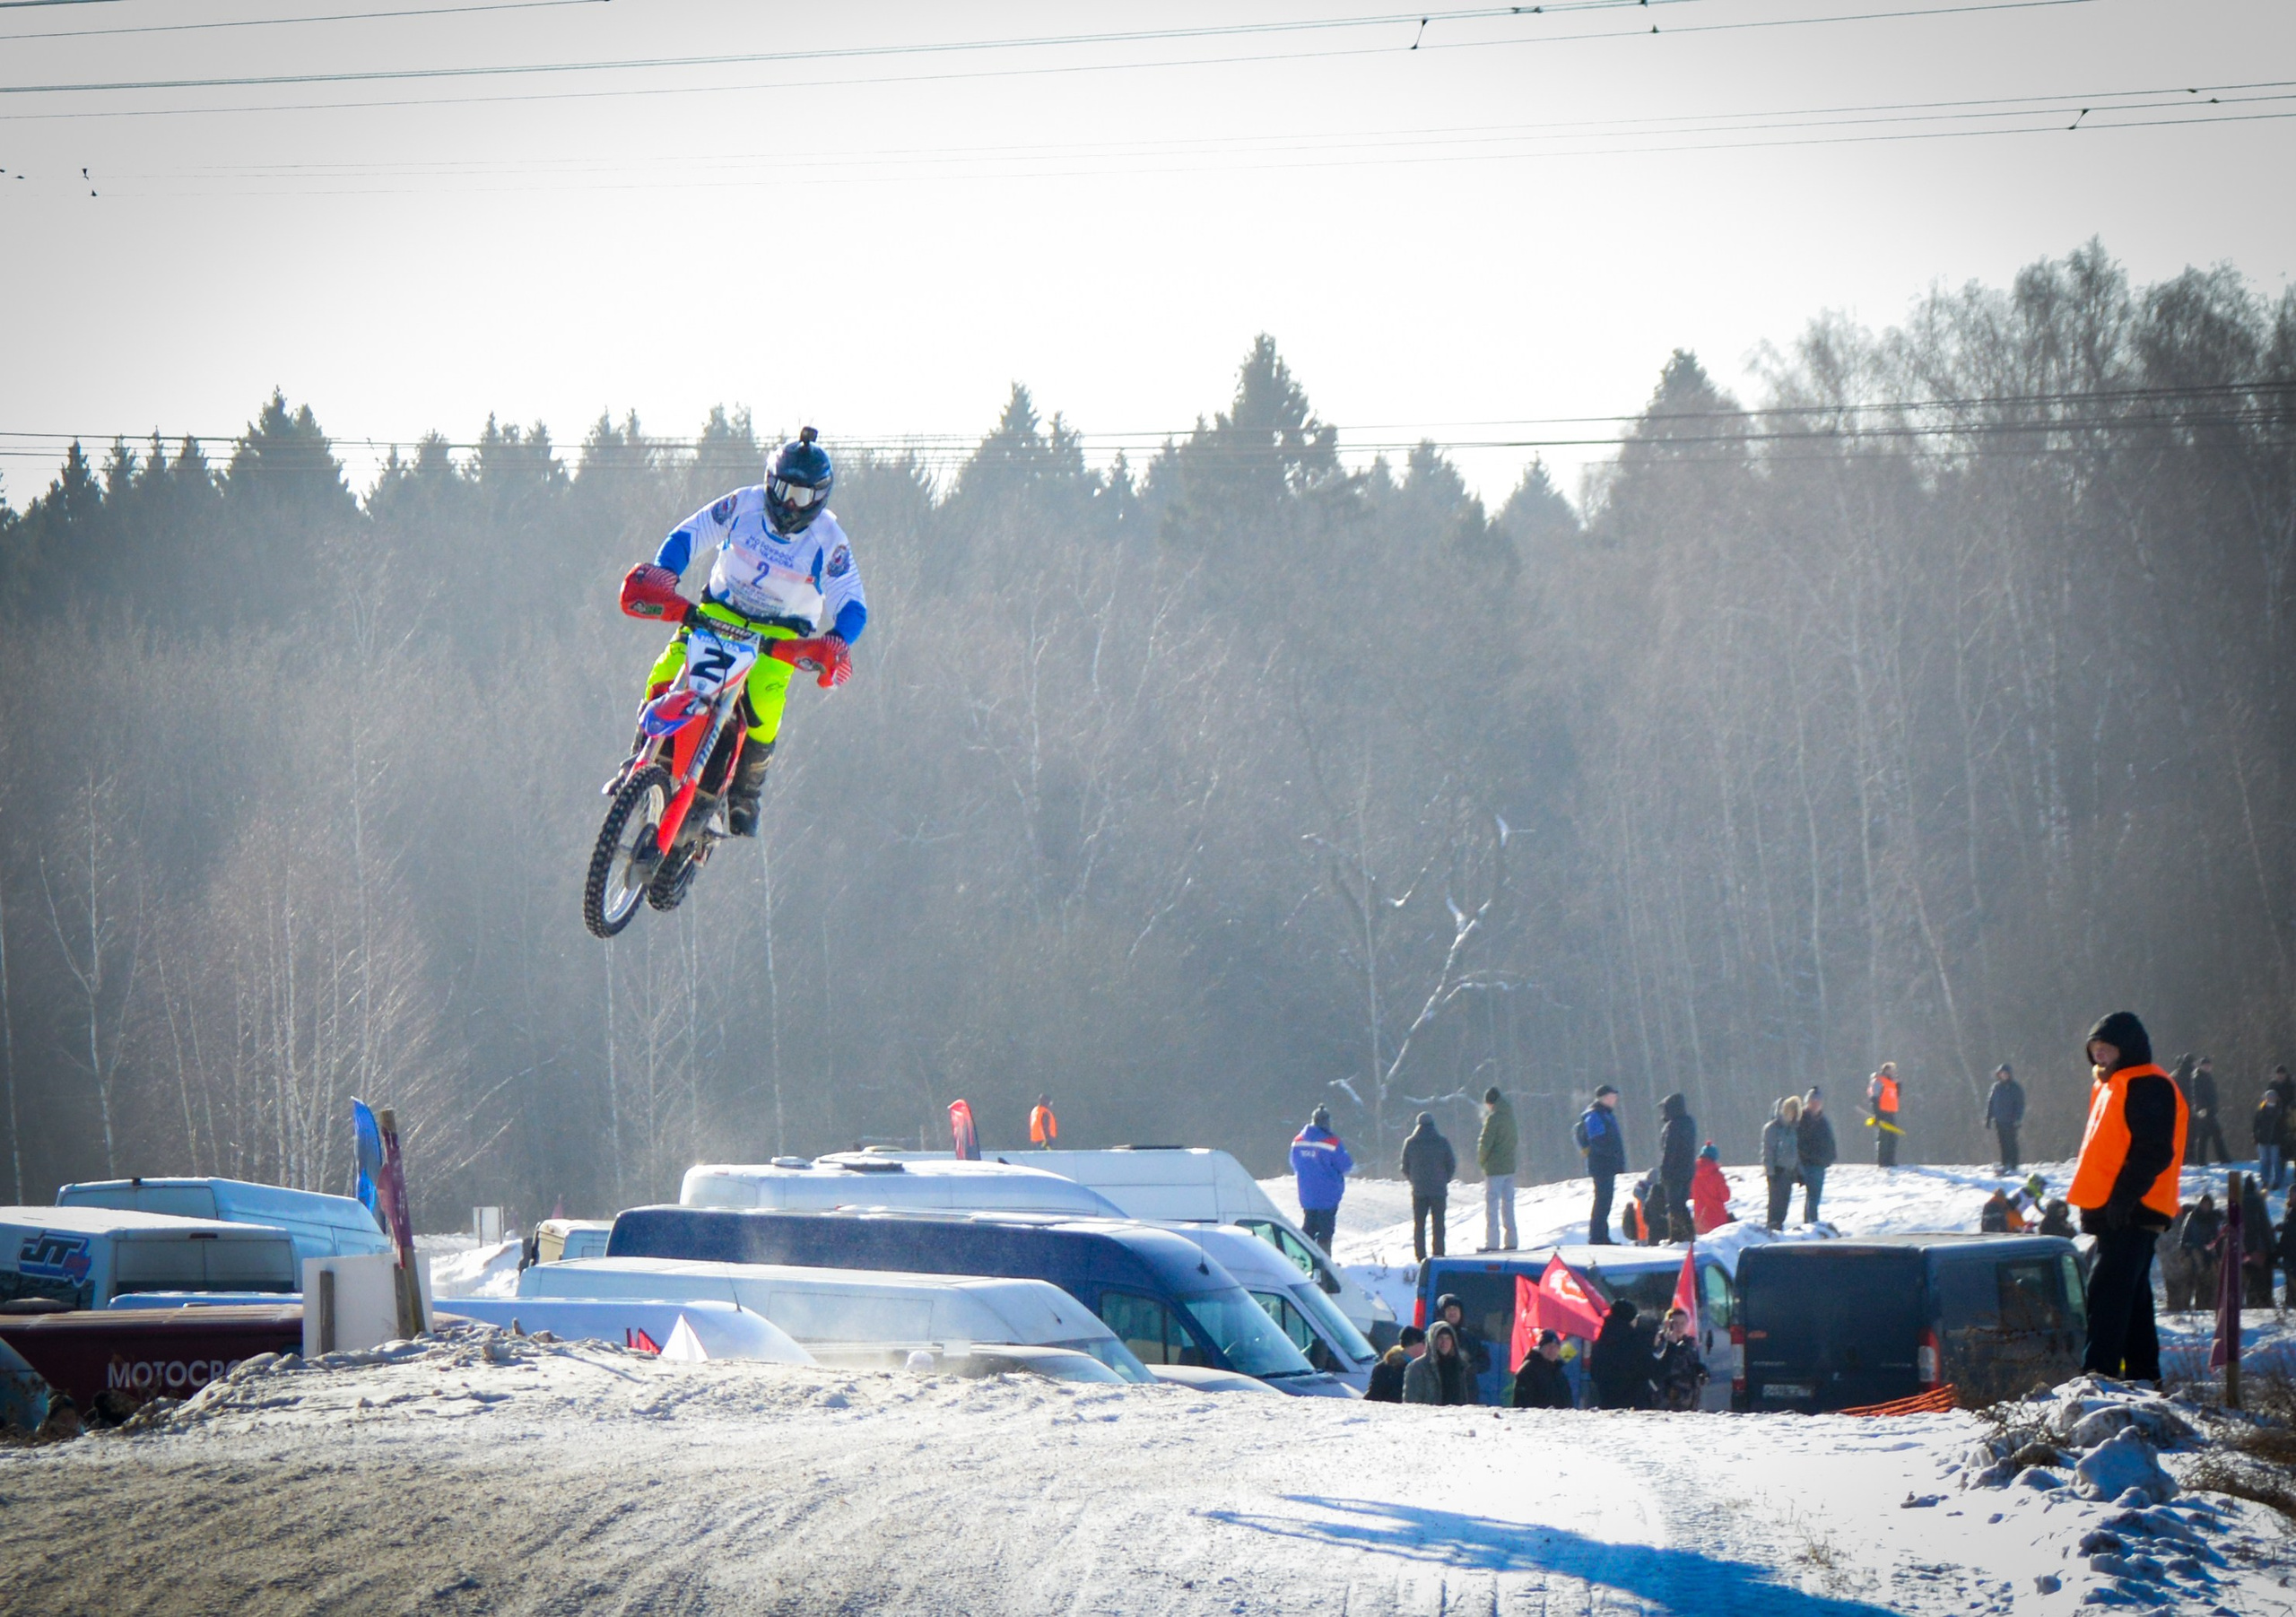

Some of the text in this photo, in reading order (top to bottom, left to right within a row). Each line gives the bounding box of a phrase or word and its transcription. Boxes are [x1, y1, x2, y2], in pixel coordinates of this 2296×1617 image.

[751, 561, 770, 589] 2
[690, 647, 737, 684] 2
[19, 1236, 87, 1266] JT
